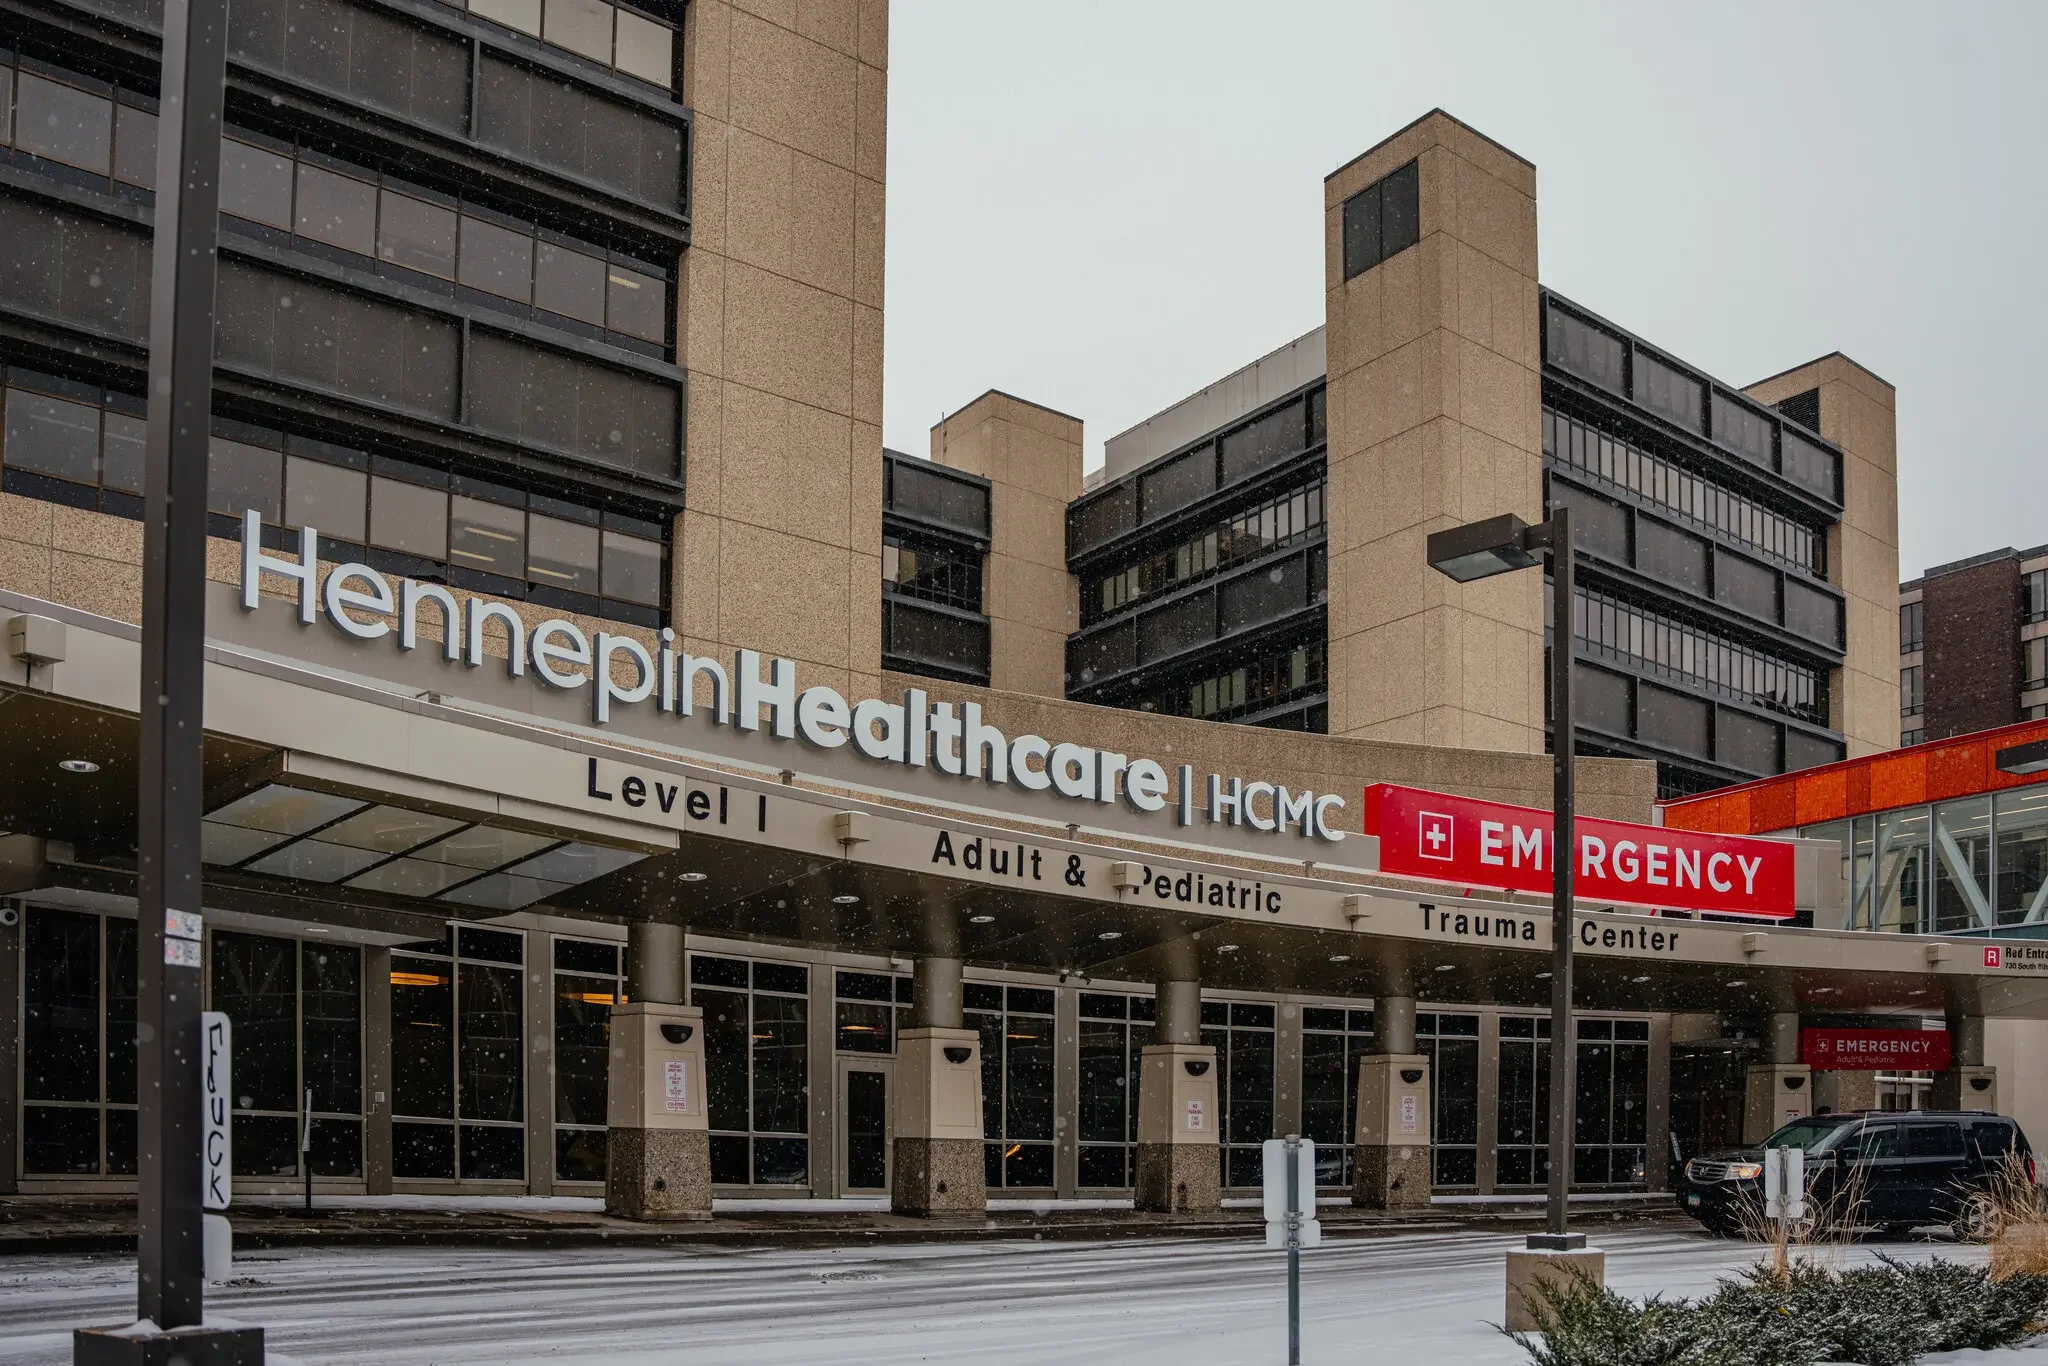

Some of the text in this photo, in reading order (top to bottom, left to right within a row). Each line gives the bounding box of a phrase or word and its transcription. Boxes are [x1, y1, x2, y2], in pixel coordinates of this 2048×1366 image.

[588, 757, 728, 825] Level
[1207, 774, 1346, 841] HCMC
[932, 830, 1042, 881] Adult
[1065, 854, 1087, 888] &
[1480, 820, 1763, 895] EMRGENCY
[1419, 903, 1679, 951] Trauma Center
[1987, 951, 1997, 963] R
[2005, 947, 2023, 959] Red
[1836, 1040, 1930, 1053] EMERGENCY
[1864, 1056, 1896, 1064] Pediatric
